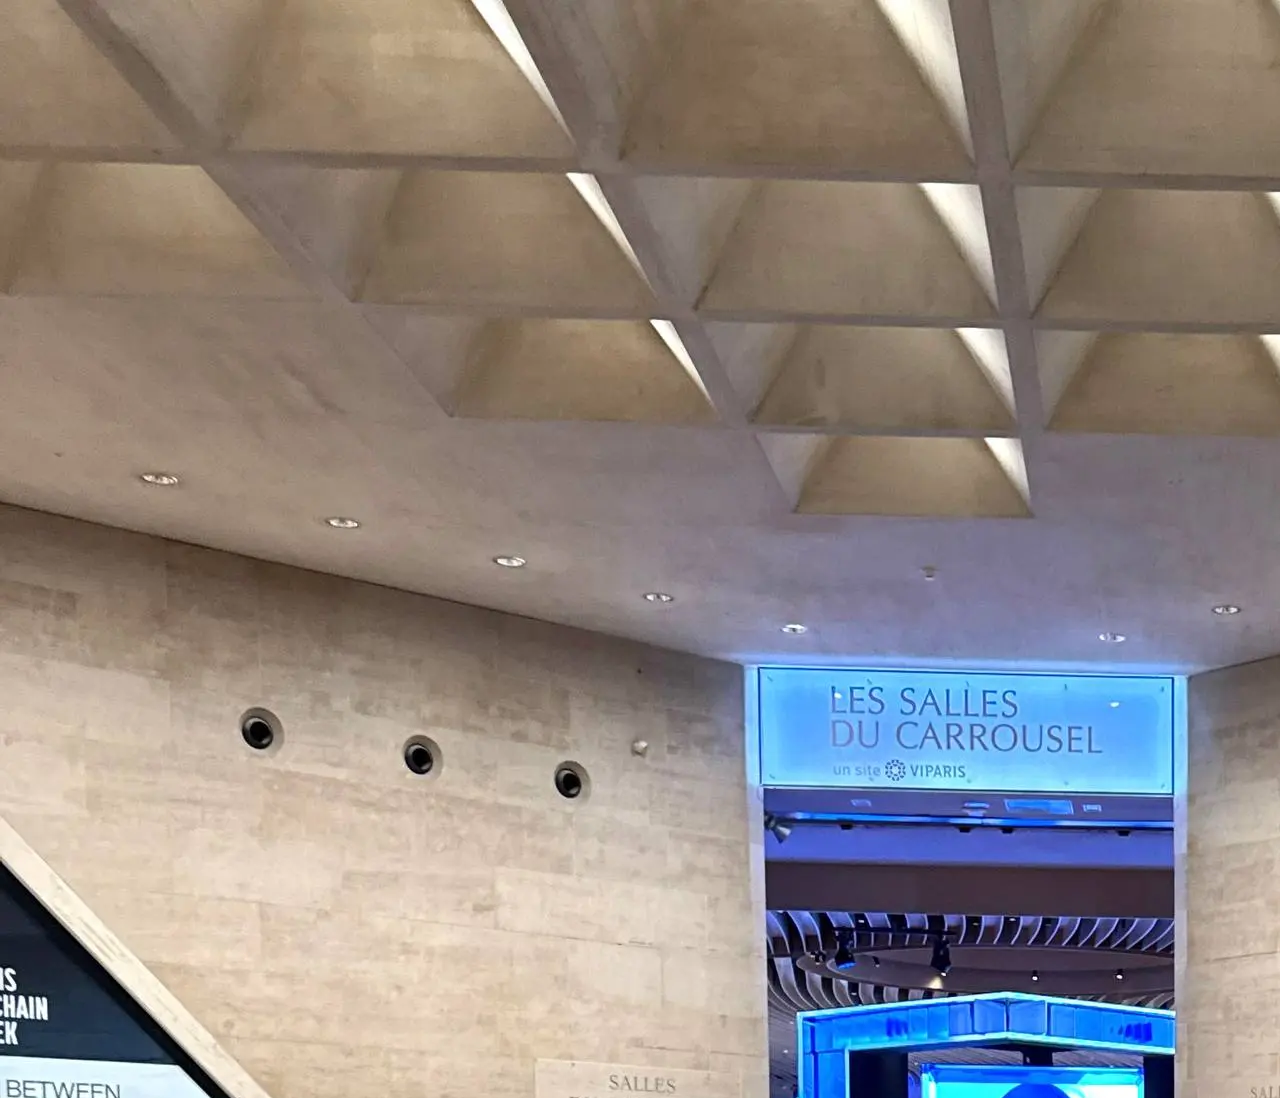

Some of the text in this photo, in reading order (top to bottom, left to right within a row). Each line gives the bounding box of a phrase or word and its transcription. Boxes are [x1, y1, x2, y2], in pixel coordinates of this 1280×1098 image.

[831, 685, 1018, 718] LES SALLES
[831, 720, 1102, 754] DU CARROUSEL
[833, 762, 966, 779] un site VIPARIS
[0, 967, 17, 992] IS
[609, 1074, 676, 1095] SALLES
